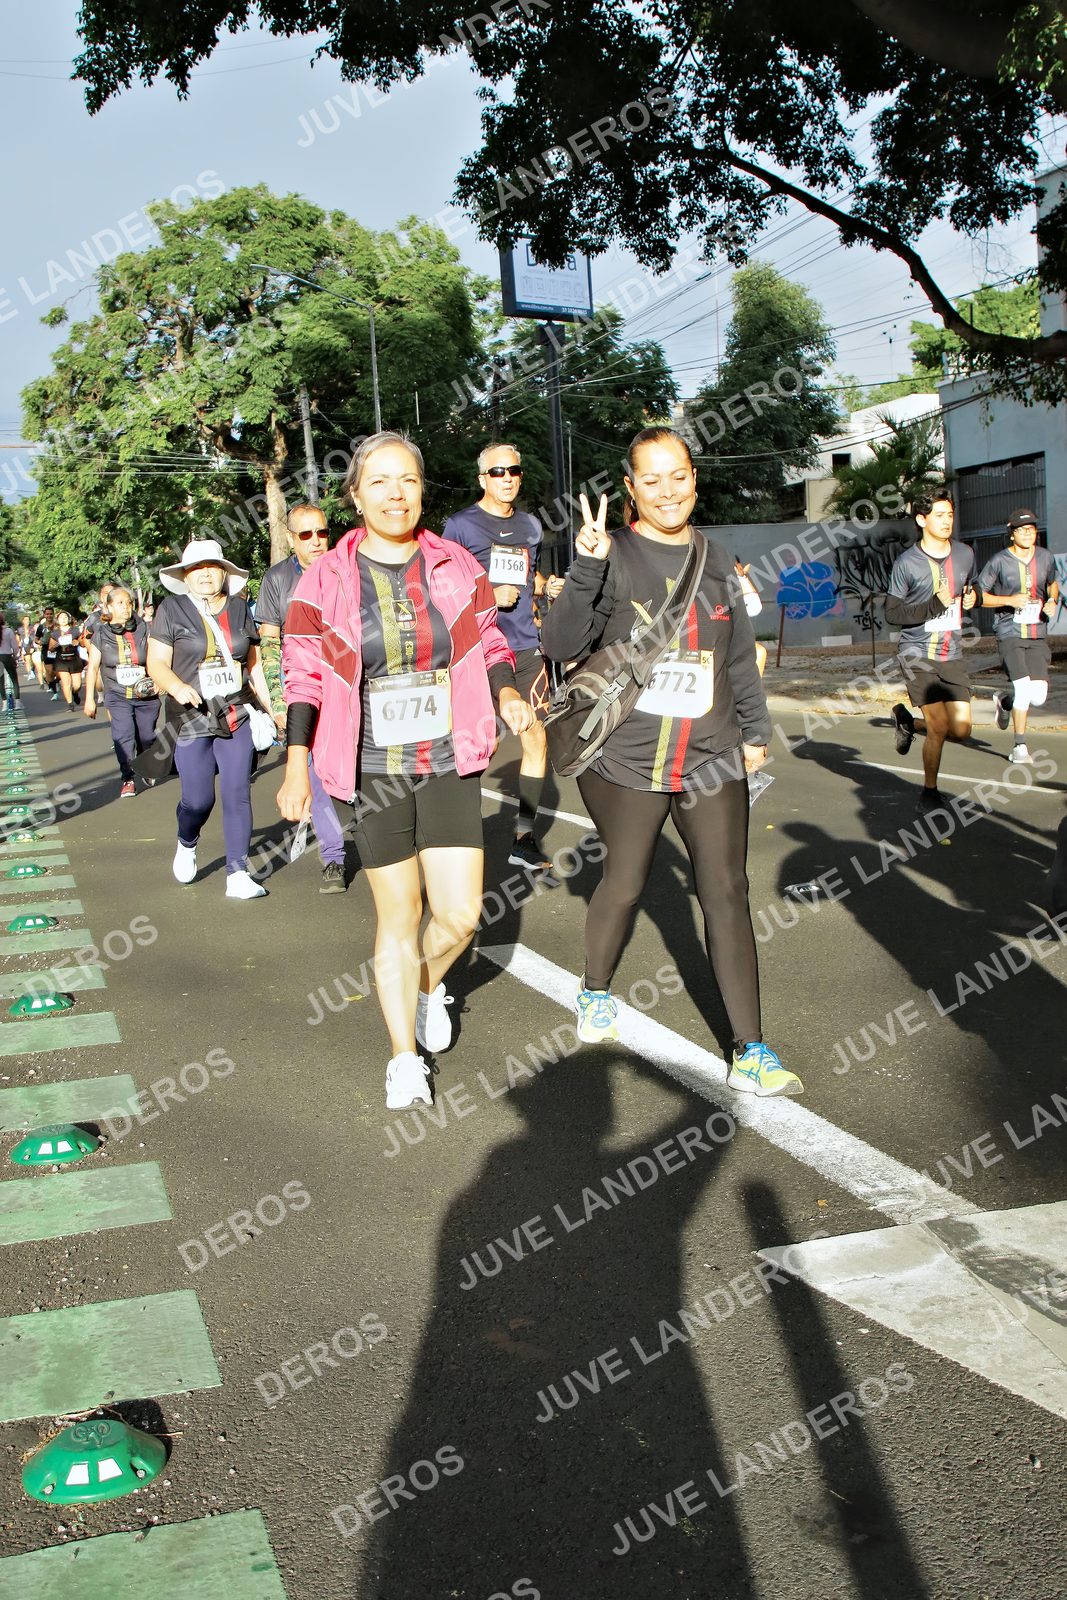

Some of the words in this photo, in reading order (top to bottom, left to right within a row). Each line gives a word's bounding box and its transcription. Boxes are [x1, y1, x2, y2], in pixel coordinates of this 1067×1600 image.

[494, 557, 525, 572] 11568
[206, 671, 234, 686] 2014
[382, 694, 438, 722] 6774
